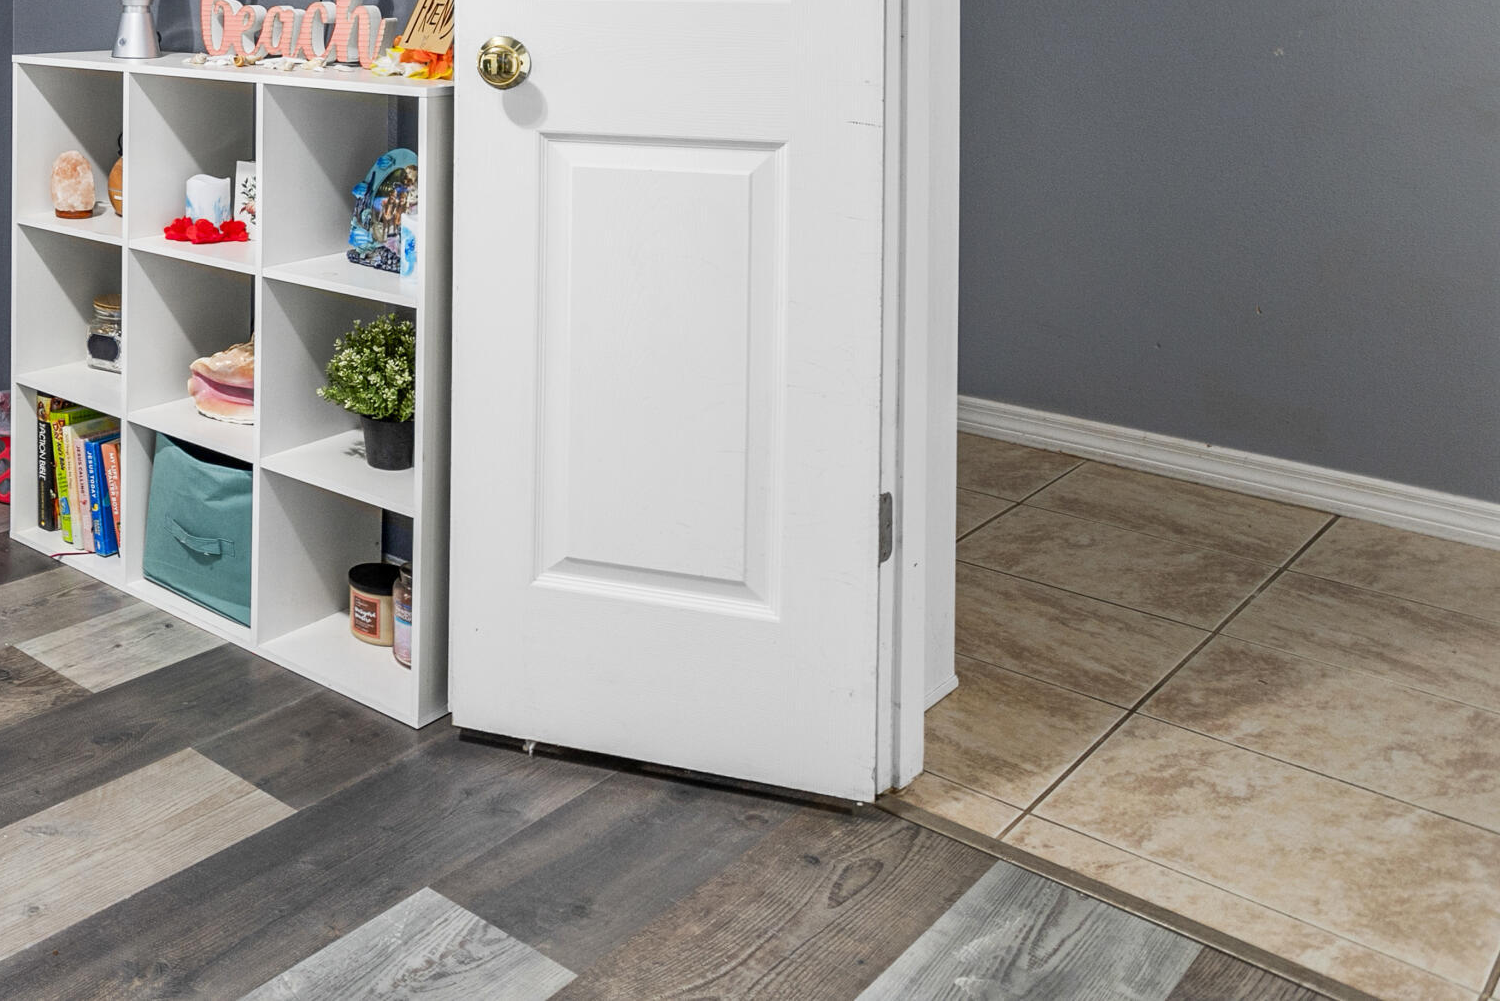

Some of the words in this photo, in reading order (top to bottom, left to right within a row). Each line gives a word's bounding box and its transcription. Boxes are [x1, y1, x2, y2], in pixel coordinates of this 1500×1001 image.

[108, 452, 116, 464] MY
[110, 464, 118, 480] LIFE
[107, 469, 116, 496] WALTER
[111, 497, 119, 515] BOYS
